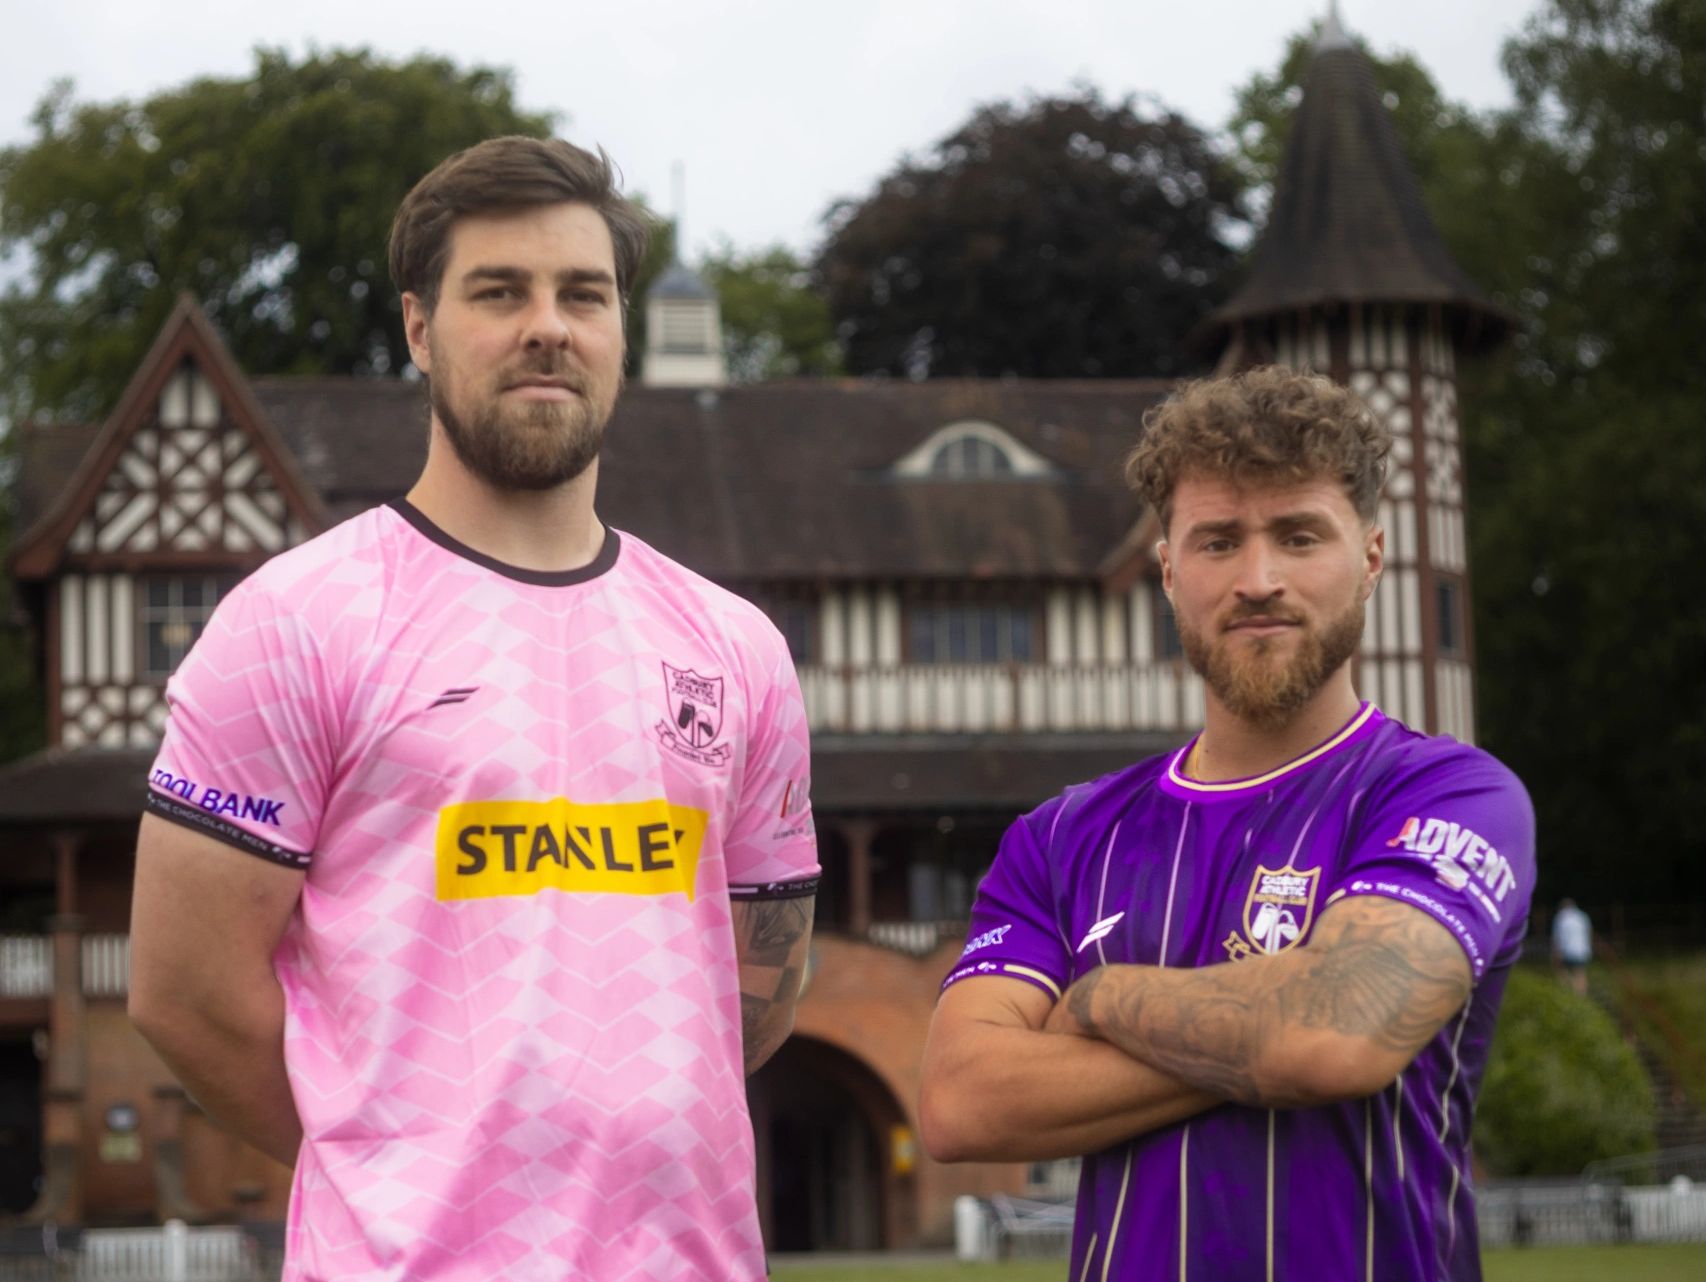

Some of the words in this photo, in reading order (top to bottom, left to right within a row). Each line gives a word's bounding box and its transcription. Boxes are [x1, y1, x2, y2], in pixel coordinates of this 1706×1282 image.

[172, 805, 240, 838] CHOCOLATE
[241, 831, 268, 850] MEN
[456, 822, 685, 876] STANLE
[1386, 816, 1516, 902] ADVENT
[1376, 882, 1401, 895] THE
[1401, 888, 1466, 934] CHOCOLATE
